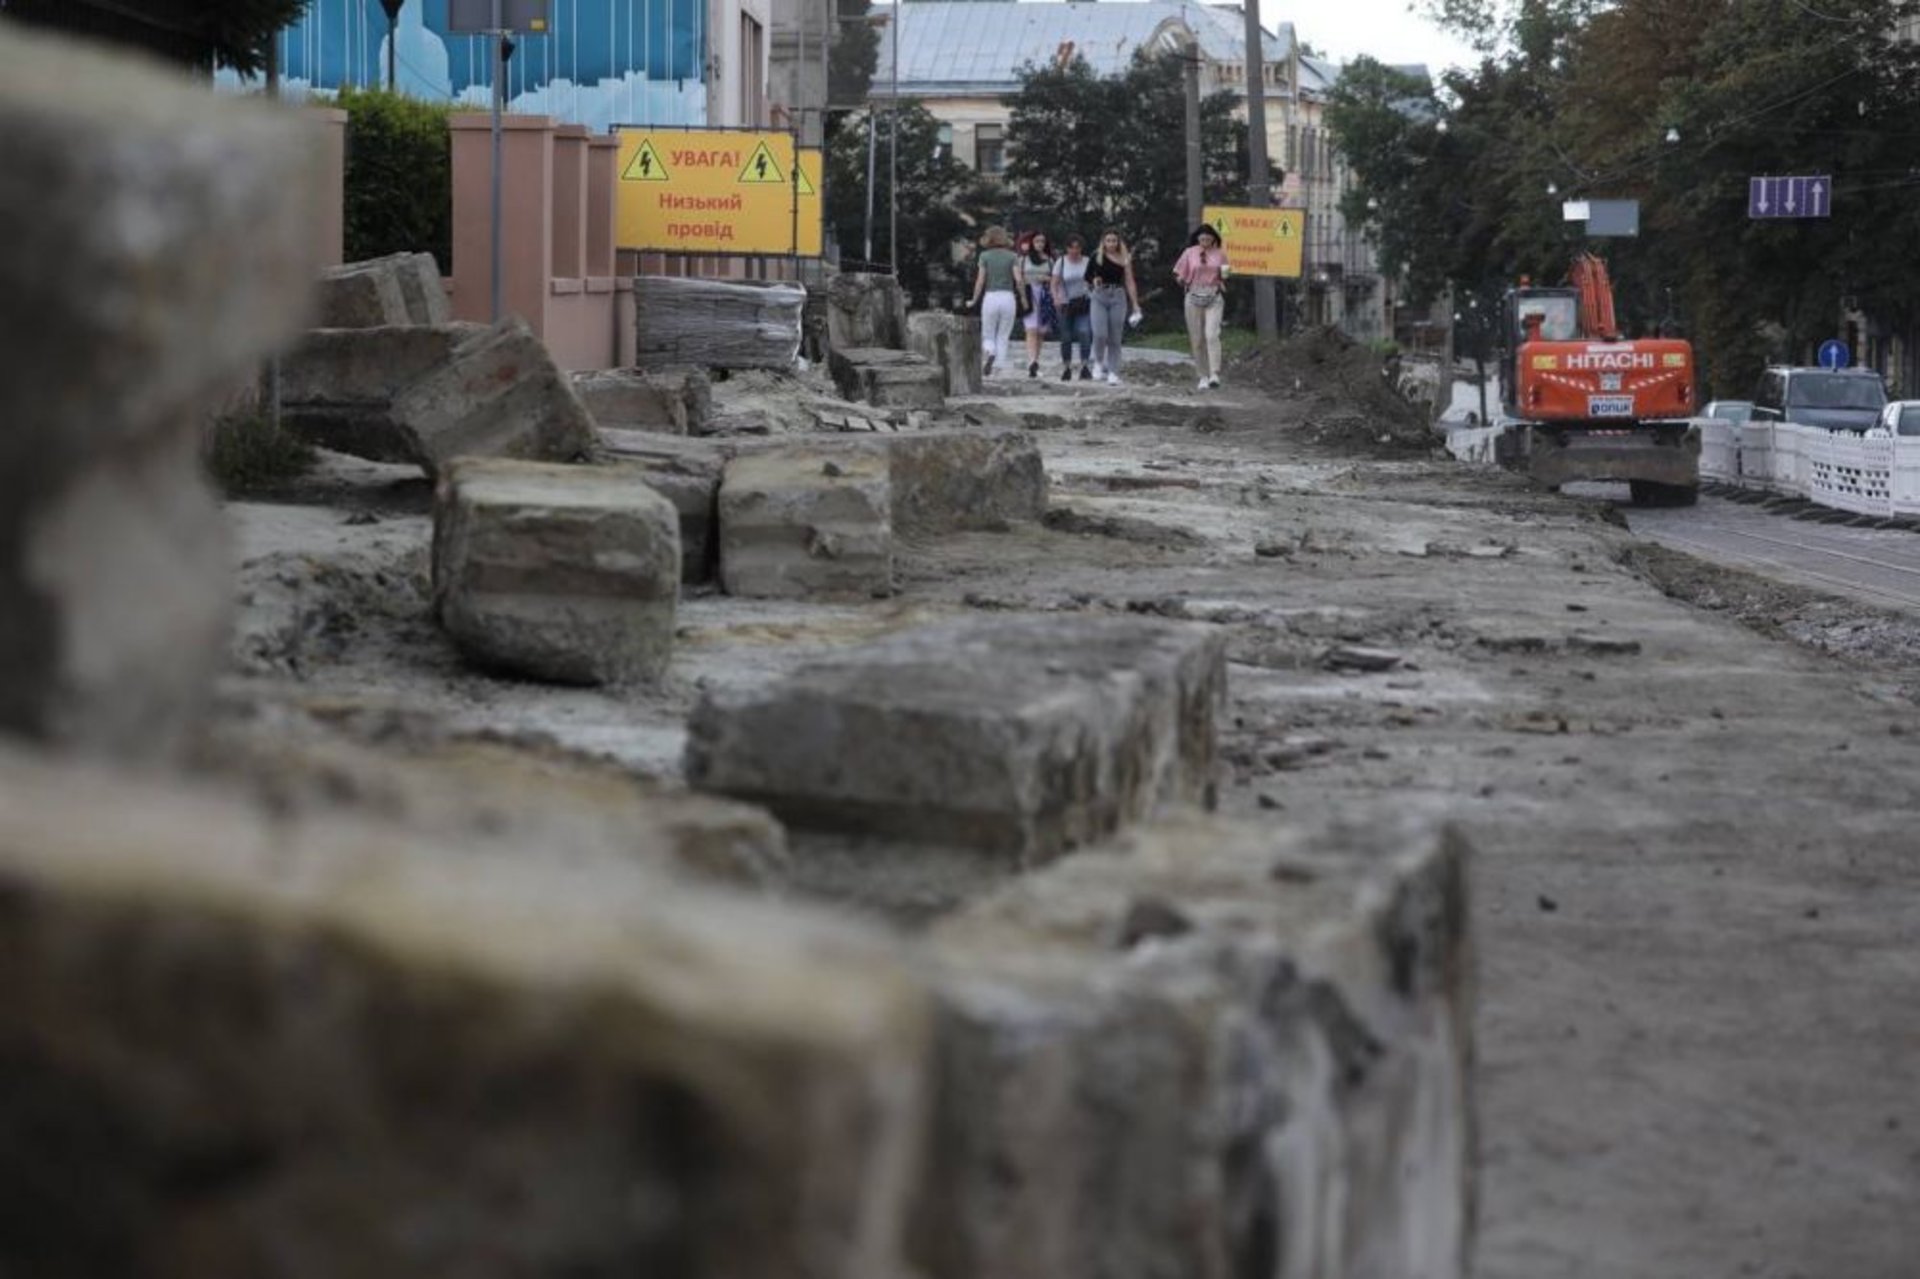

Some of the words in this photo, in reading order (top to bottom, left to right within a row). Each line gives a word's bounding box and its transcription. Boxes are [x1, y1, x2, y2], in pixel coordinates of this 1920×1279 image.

[671, 150, 740, 168] УВАГА!
[659, 193, 742, 211] Низький
[667, 220, 734, 240] провід
[1567, 353, 1654, 368] HITACHI
